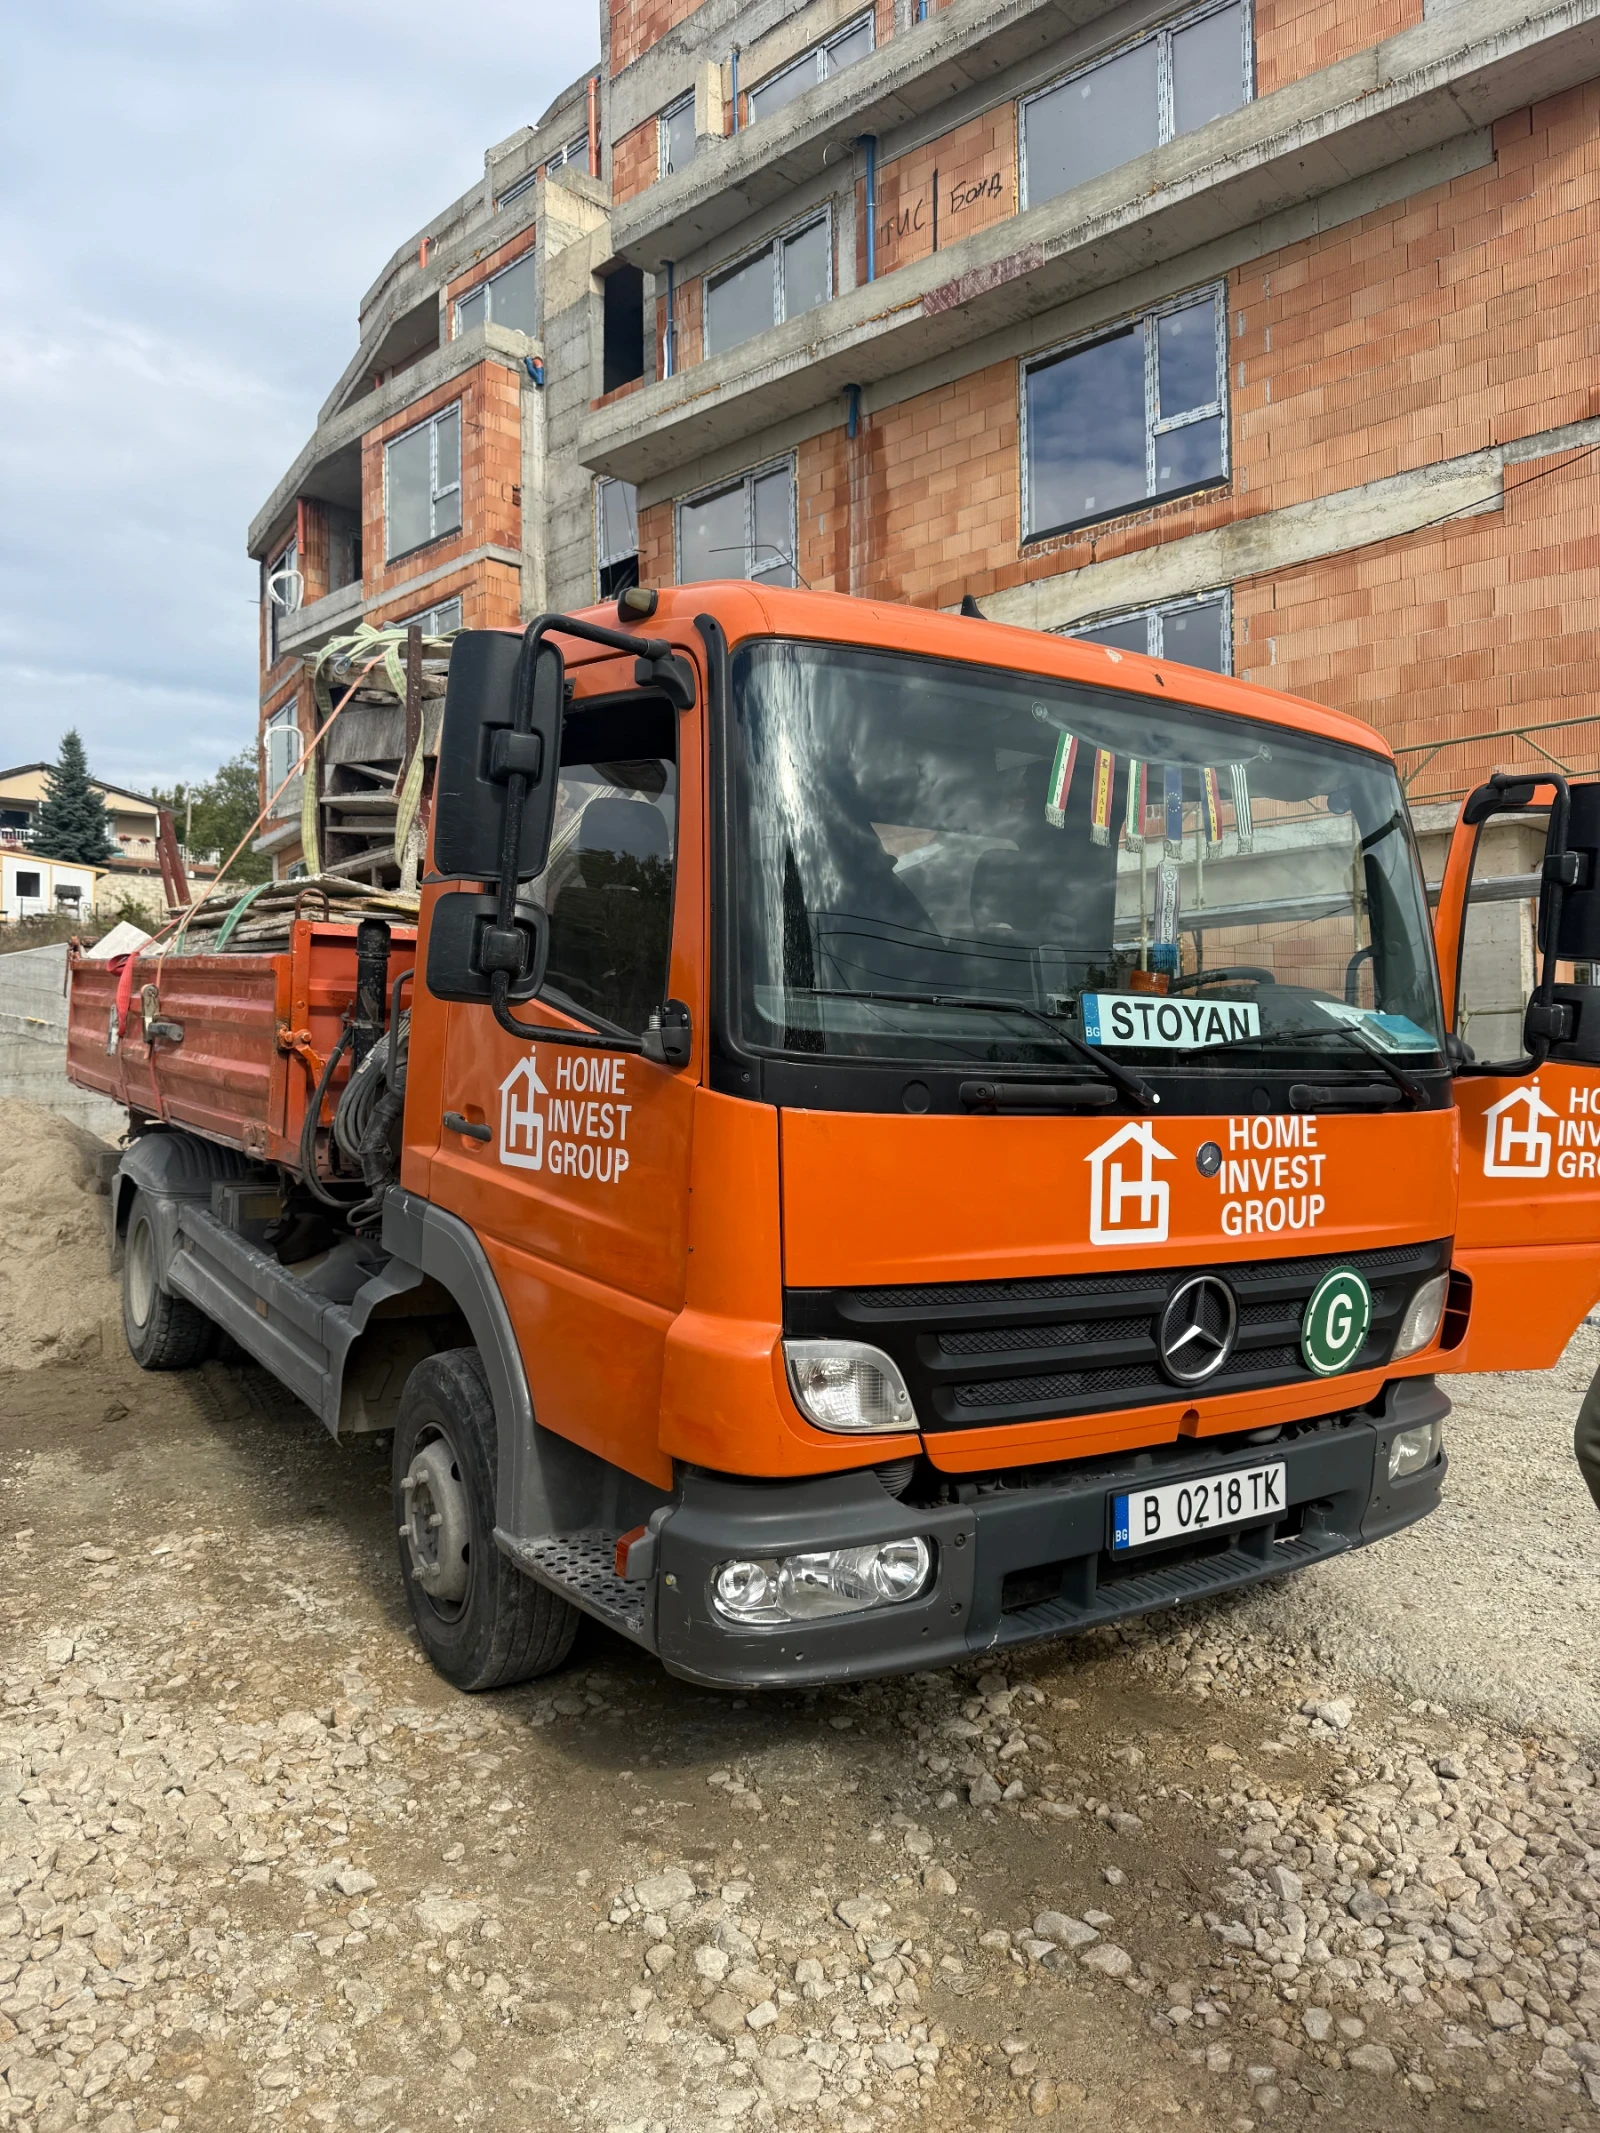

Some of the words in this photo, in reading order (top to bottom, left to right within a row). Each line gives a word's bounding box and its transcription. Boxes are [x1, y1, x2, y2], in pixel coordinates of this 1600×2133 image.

[1164, 884, 1174, 943] MERCEDES
[1086, 1026, 1100, 1037] BG
[1111, 1001, 1251, 1043] STOYAN
[556, 1056, 626, 1095] HOME
[548, 1098, 632, 1161] INVEST
[1229, 1115, 1318, 1151] HOME
[548, 1140, 629, 1183] GROUP
[1219, 1154, 1326, 1194] INVEST
[1557, 1151, 1600, 1178] GR
[1221, 1194, 1326, 1236] GROUP
[1325, 1293, 1353, 1349] G
[1115, 1528, 1128, 1542] BG
